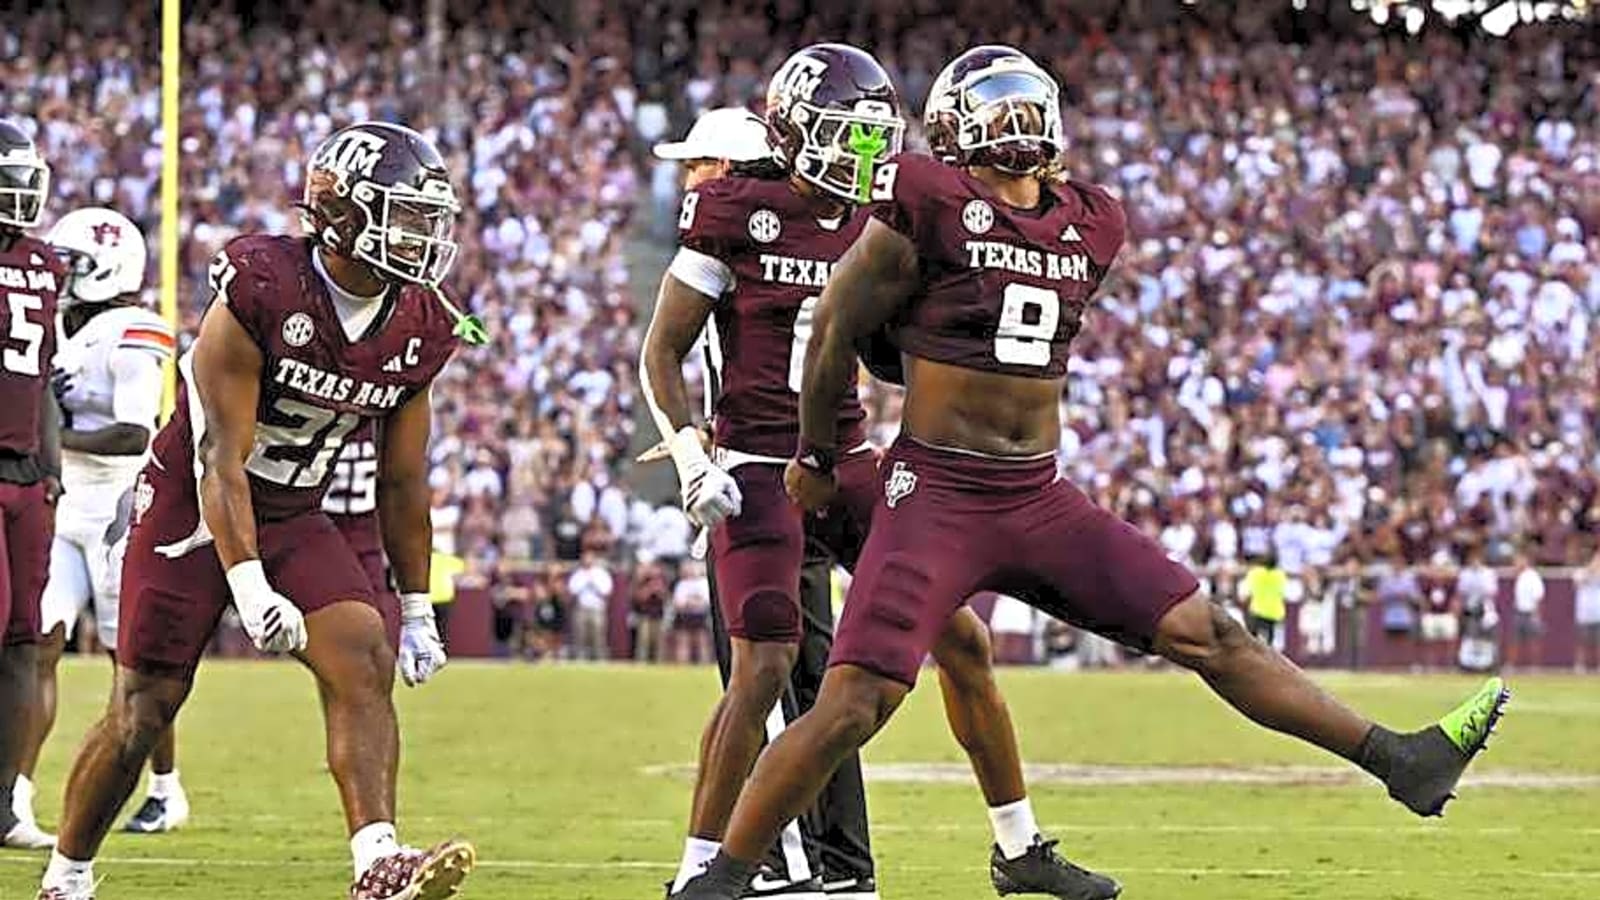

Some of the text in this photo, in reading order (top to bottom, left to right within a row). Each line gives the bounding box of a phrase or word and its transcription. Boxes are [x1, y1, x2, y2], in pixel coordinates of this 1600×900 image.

[872, 163, 898, 200] 9
[679, 192, 700, 230] 8
[750, 214, 780, 239] SEC
[208, 250, 237, 300] 21
[760, 254, 838, 287] TEXA
[965, 241, 1088, 282] TEXAS A&M
[3, 292, 45, 376] 5
[405, 337, 422, 366] C
[274, 358, 406, 409] TEXAS A&M
[244, 398, 360, 488] 21
